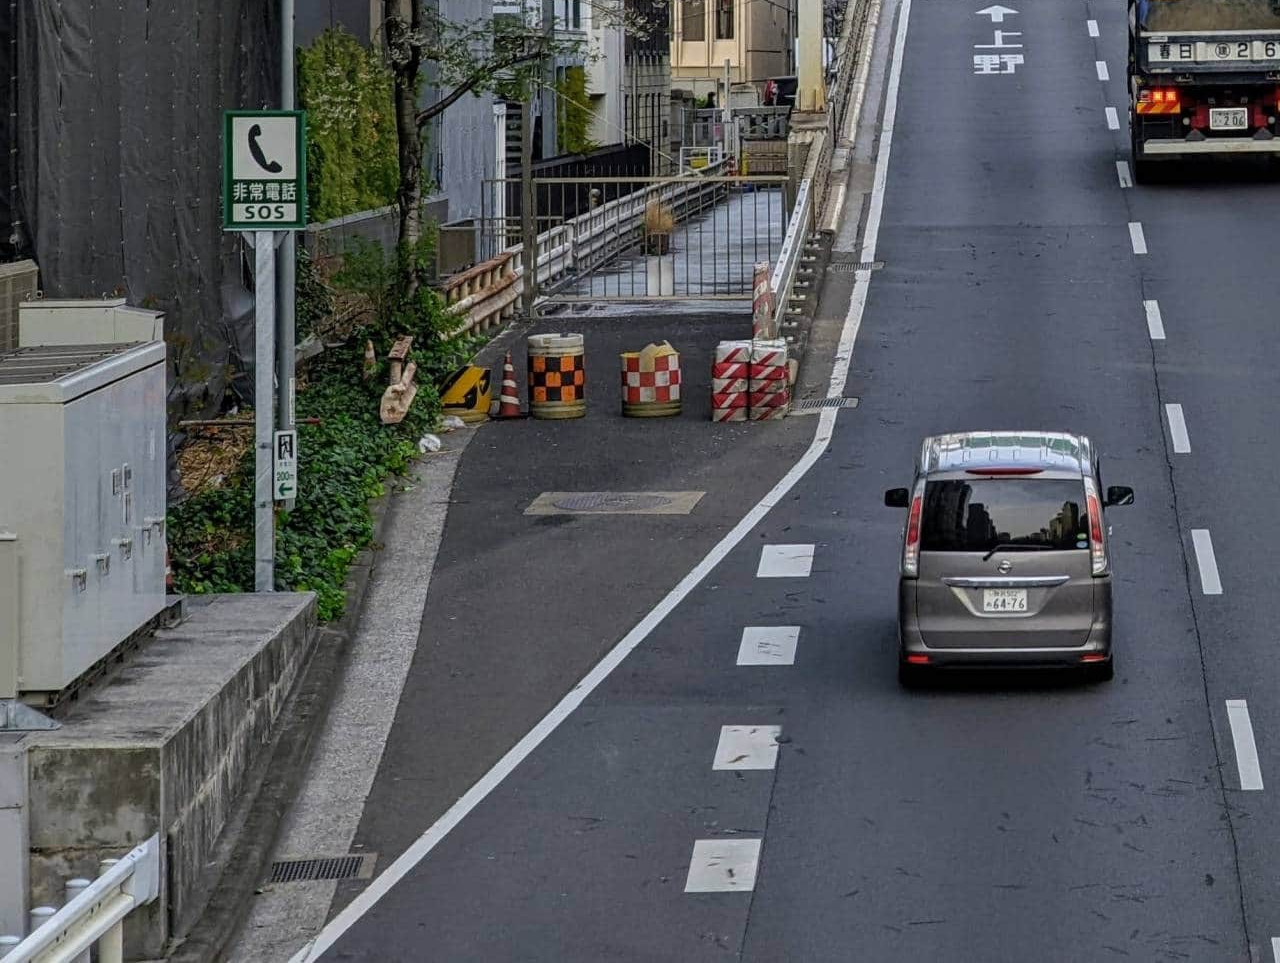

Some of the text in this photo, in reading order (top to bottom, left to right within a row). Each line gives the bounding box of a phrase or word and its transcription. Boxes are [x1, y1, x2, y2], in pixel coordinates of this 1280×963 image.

[973, 30, 1025, 75] 上野
[232, 181, 297, 202] 非常電話
[244, 205, 285, 220] SOS
[993, 597, 1025, 610] 64-76
